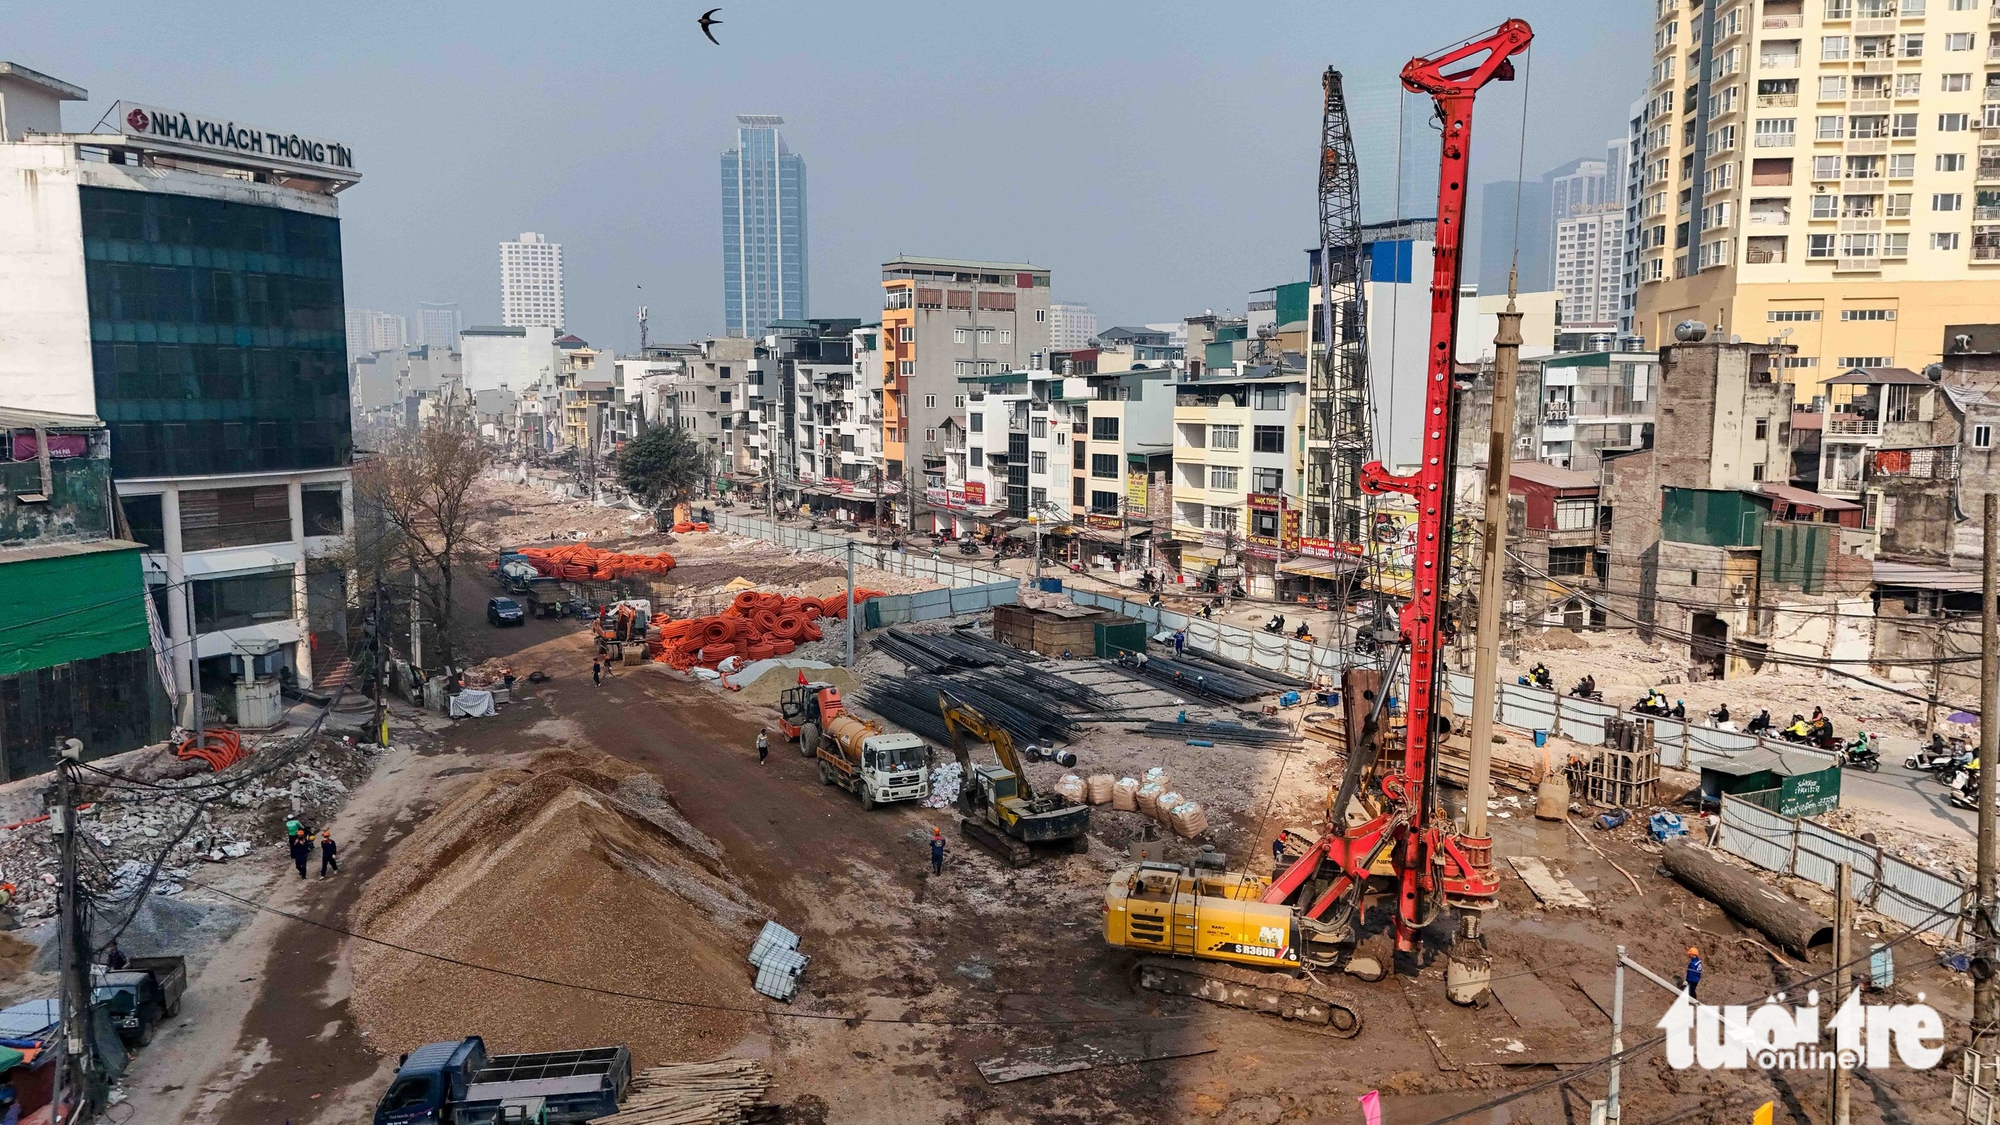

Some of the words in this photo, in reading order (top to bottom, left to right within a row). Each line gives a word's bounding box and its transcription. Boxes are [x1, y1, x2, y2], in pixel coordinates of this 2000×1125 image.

[150, 110, 194, 141] NHÀ
[196, 119, 263, 153] KHÁCH
[265, 134, 325, 162] THÔNG
